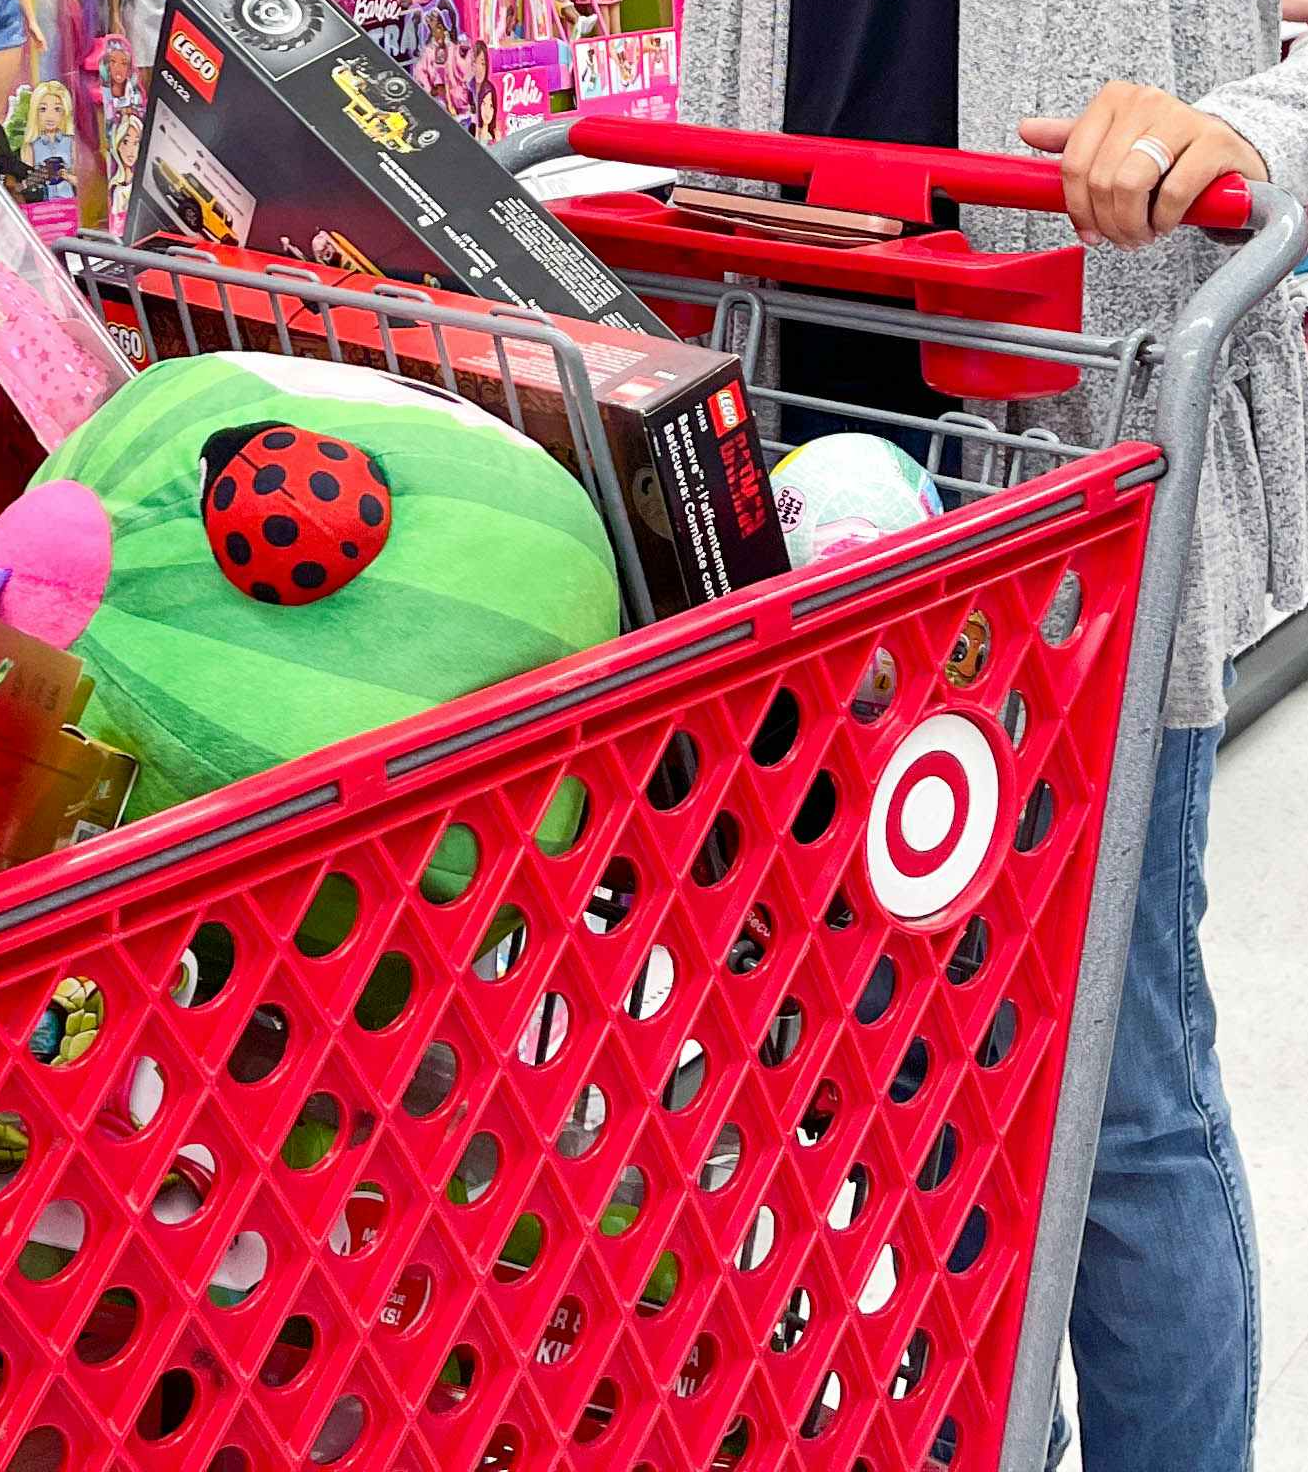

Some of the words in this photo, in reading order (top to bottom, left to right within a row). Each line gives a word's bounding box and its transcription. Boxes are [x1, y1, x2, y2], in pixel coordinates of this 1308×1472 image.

[171, 33, 218, 80] LEGO
[160, 69, 191, 103] 42122
[502, 73, 542, 111] Barbie
[108, 325, 145, 362] EGO
[717, 390, 739, 428] LEGO
[684, 503, 709, 568] Combate
[699, 492, 733, 593] l'affrontement
